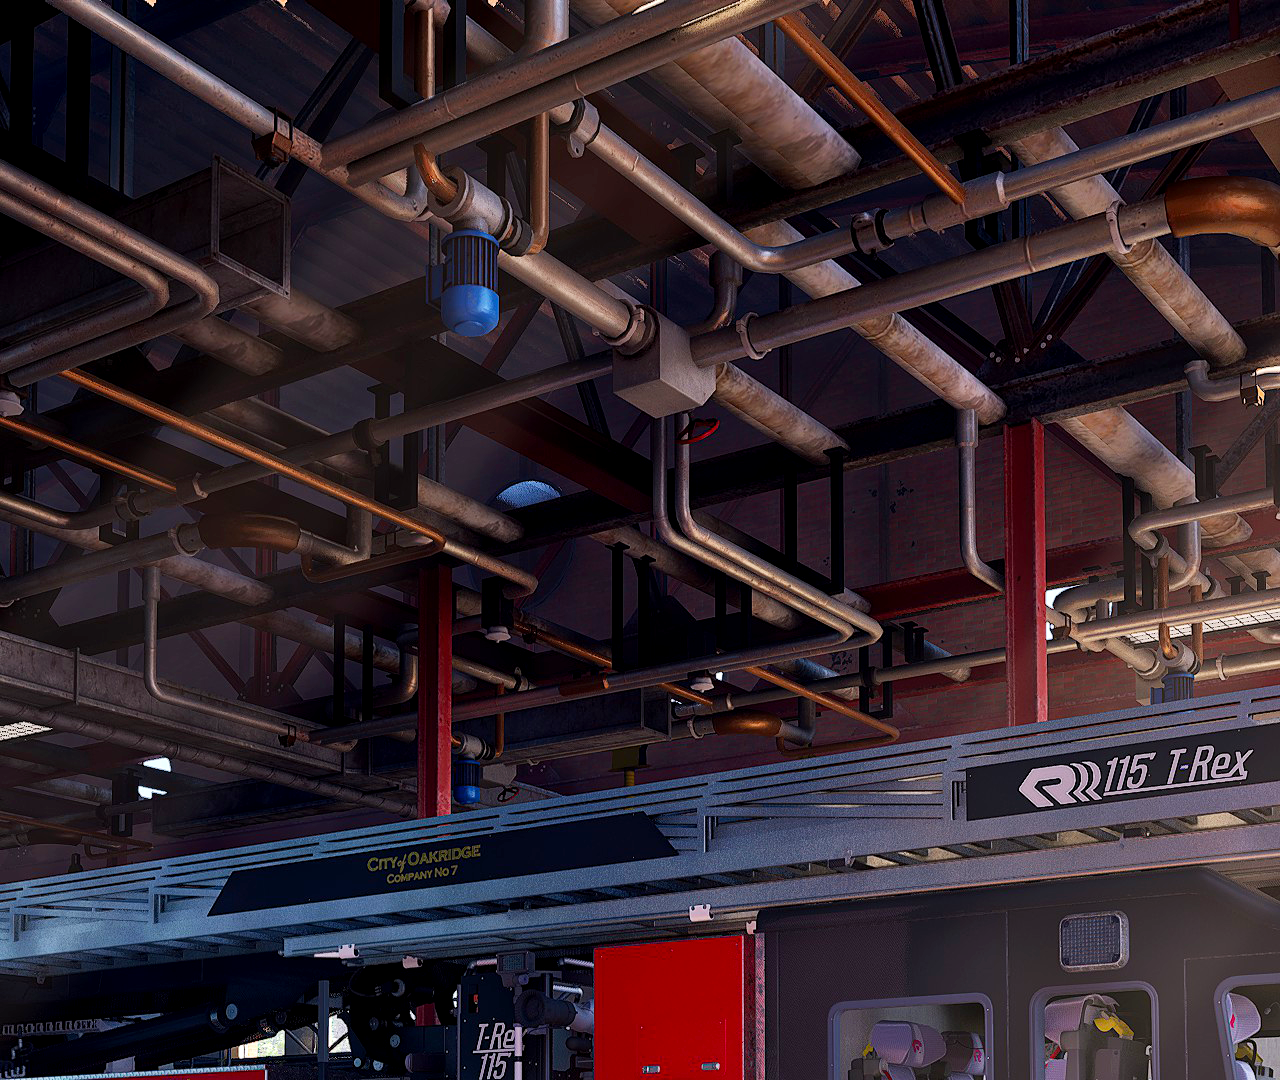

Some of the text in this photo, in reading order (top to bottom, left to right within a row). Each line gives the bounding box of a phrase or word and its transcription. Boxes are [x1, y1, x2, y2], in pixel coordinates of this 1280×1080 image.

[1167, 745, 1254, 785] T-Rex
[367, 844, 481, 874] CITY of OAKRIDGE
[387, 870, 432, 883] COMPANY
[451, 864, 459, 876] 7
[476, 1022, 528, 1051] T-Re
